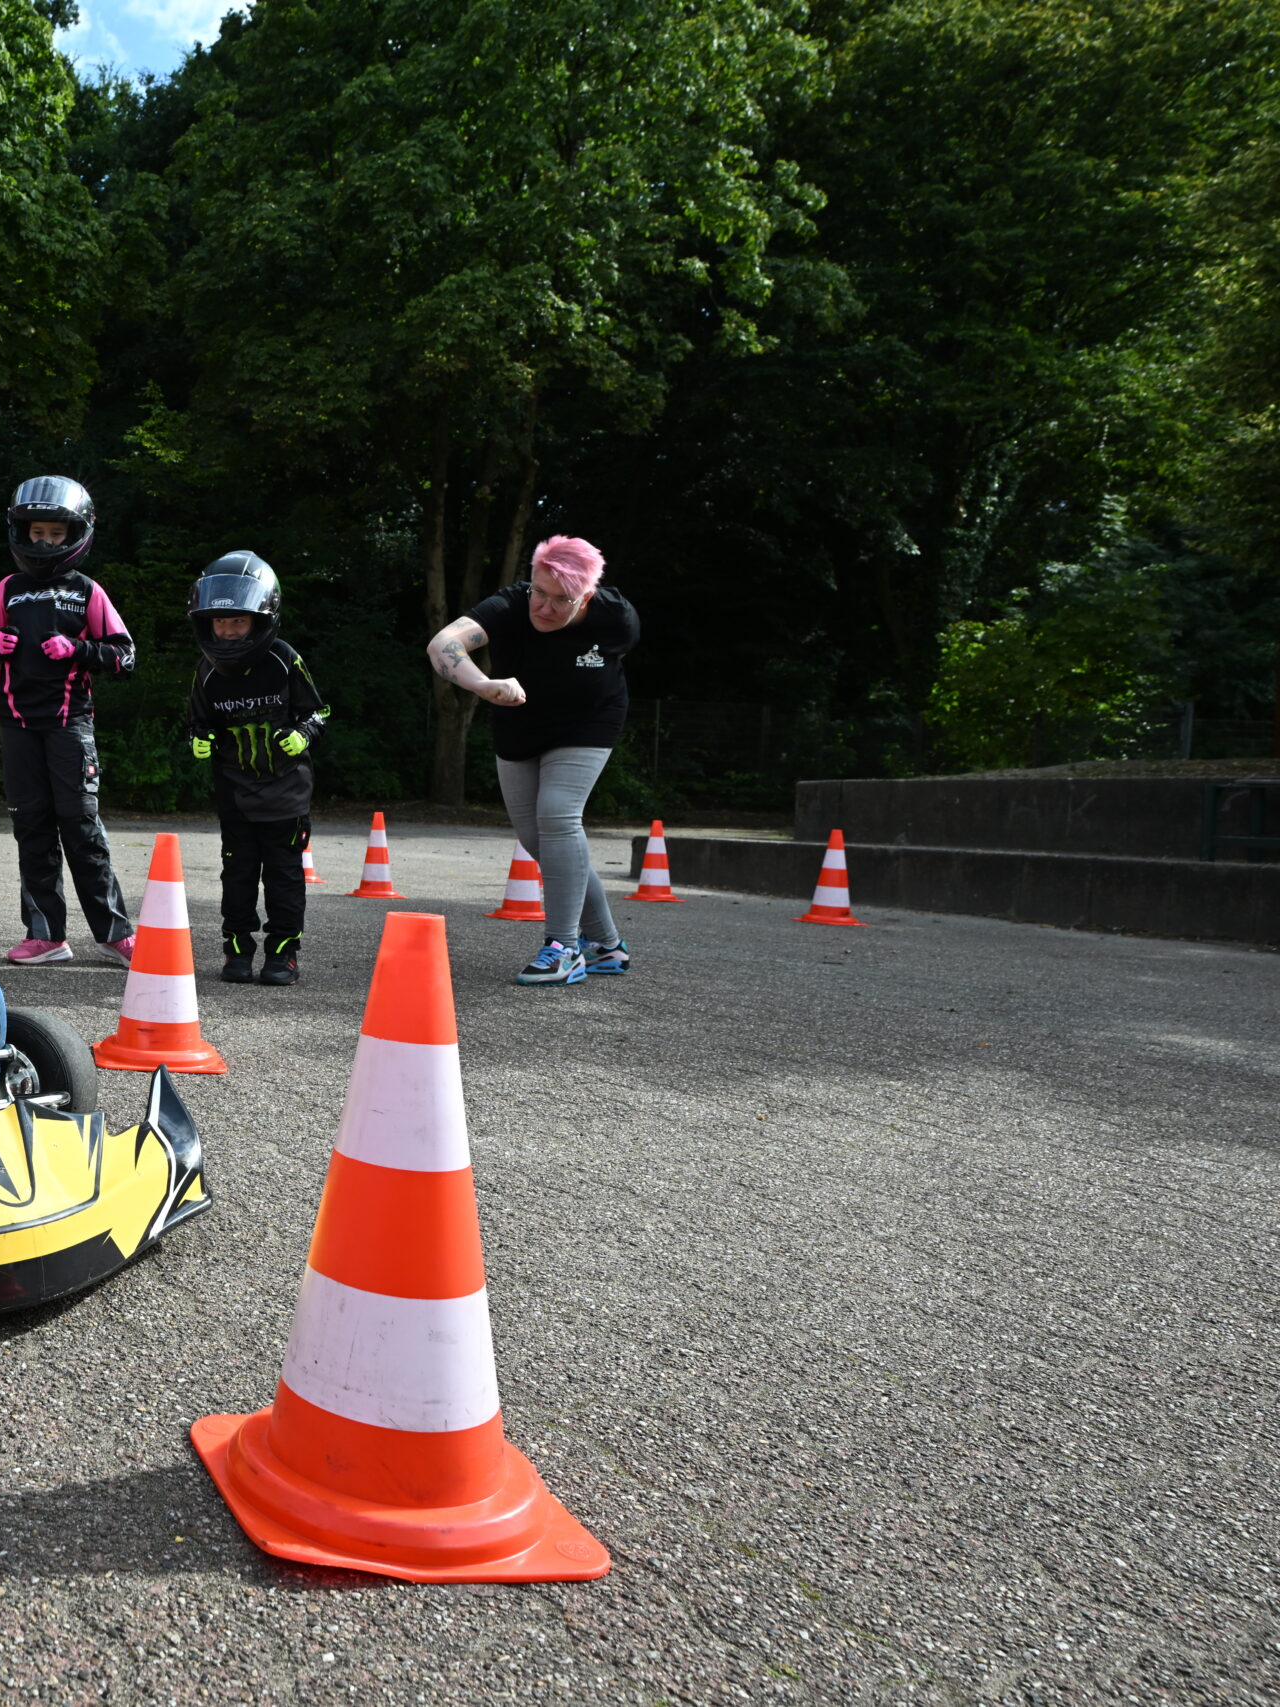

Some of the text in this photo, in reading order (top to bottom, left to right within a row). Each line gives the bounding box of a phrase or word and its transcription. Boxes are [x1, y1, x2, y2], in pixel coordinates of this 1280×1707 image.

[27, 503, 61, 511] LS2
[54, 600, 86, 615] Racing
[213, 694, 283, 713] MONSTER
